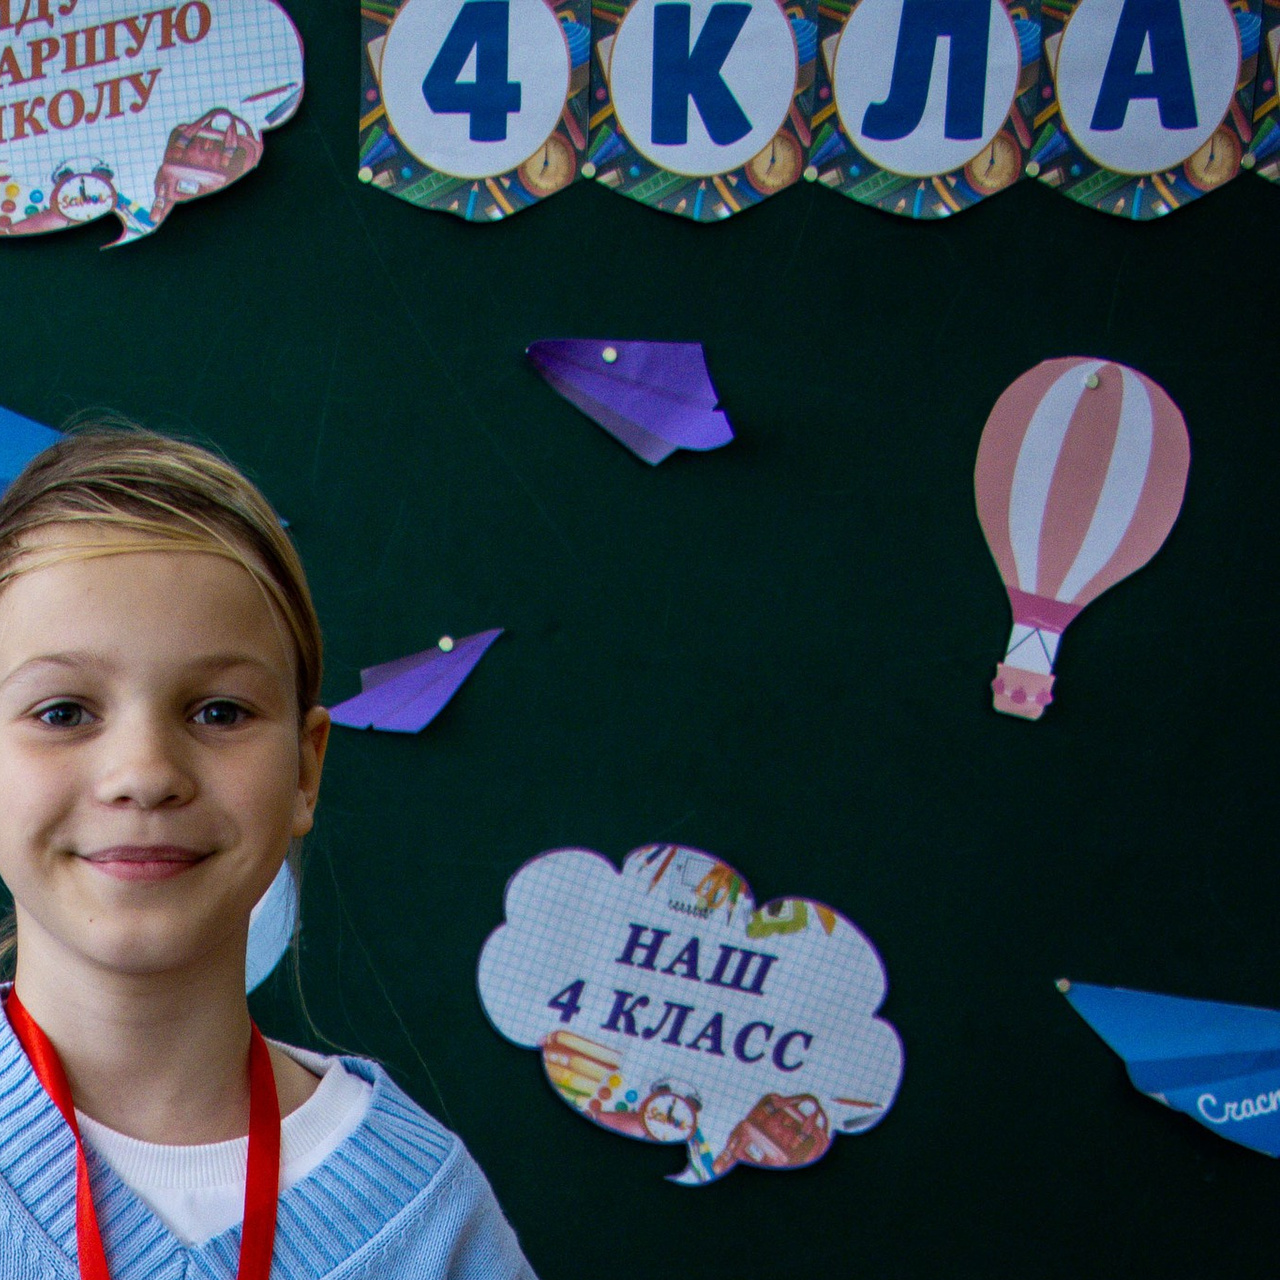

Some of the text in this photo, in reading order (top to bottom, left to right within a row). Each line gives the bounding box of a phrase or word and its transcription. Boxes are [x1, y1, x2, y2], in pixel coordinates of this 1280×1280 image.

[421, 0, 1199, 147] 4 КЛА
[614, 922, 780, 998] НАШ
[546, 977, 815, 1073] 4 КЛАСС
